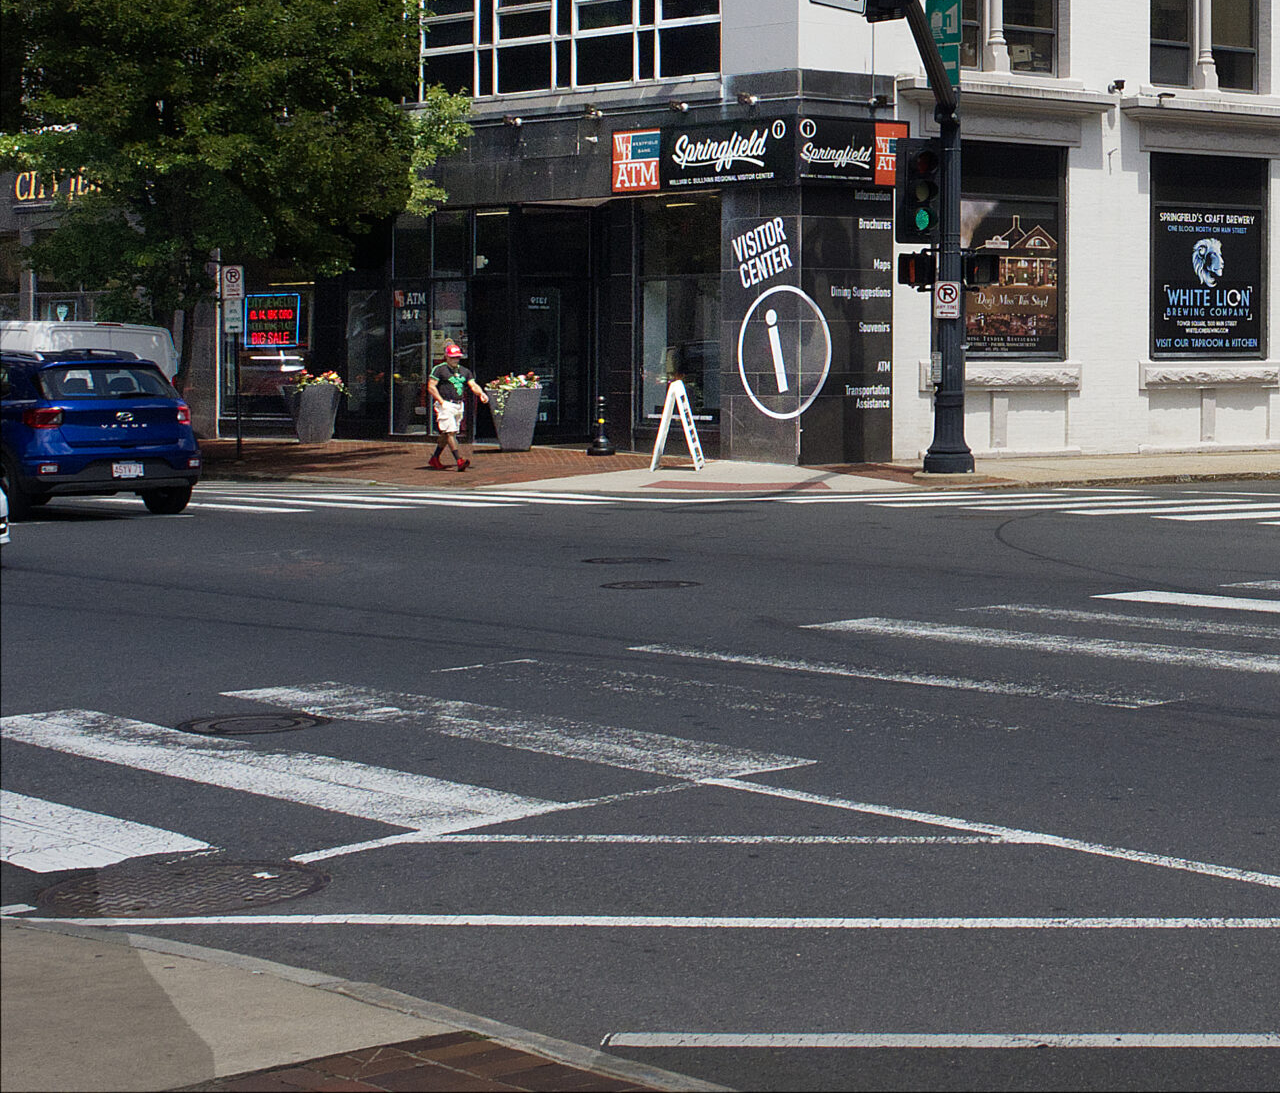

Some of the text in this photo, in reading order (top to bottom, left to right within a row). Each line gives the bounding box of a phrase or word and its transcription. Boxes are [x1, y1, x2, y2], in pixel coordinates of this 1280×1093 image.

[672, 128, 769, 172] Springfield
[800, 142, 872, 169] Springfield
[877, 156, 896, 170] AT
[615, 162, 658, 188] ATM
[855, 190, 891, 200] Information
[858, 218, 891, 230] Brochures
[1160, 212, 1255, 225] SPRINGFIELD'S CRAFT BREWERY
[732, 217, 787, 262] VISITOR
[739, 243, 793, 289] CENTER
[873, 258, 891, 272] Maps
[406, 292, 426, 305] ATM
[830, 286, 891, 299] Dining Suggestions
[1167, 289, 1250, 307] WHITE LION
[402, 310, 420, 320] 24/7
[1166, 308, 1249, 317] BREWING COMPANY
[858, 321, 890, 332] Souvenirs
[251, 331, 290, 344] BIG SALE
[1155, 338, 1258, 347] VISIT OUR TAPROOM & KITCHEN
[877, 361, 891, 372] ATM
[845, 384, 890, 397] Transportation
[855, 398, 890, 409] Assistance
